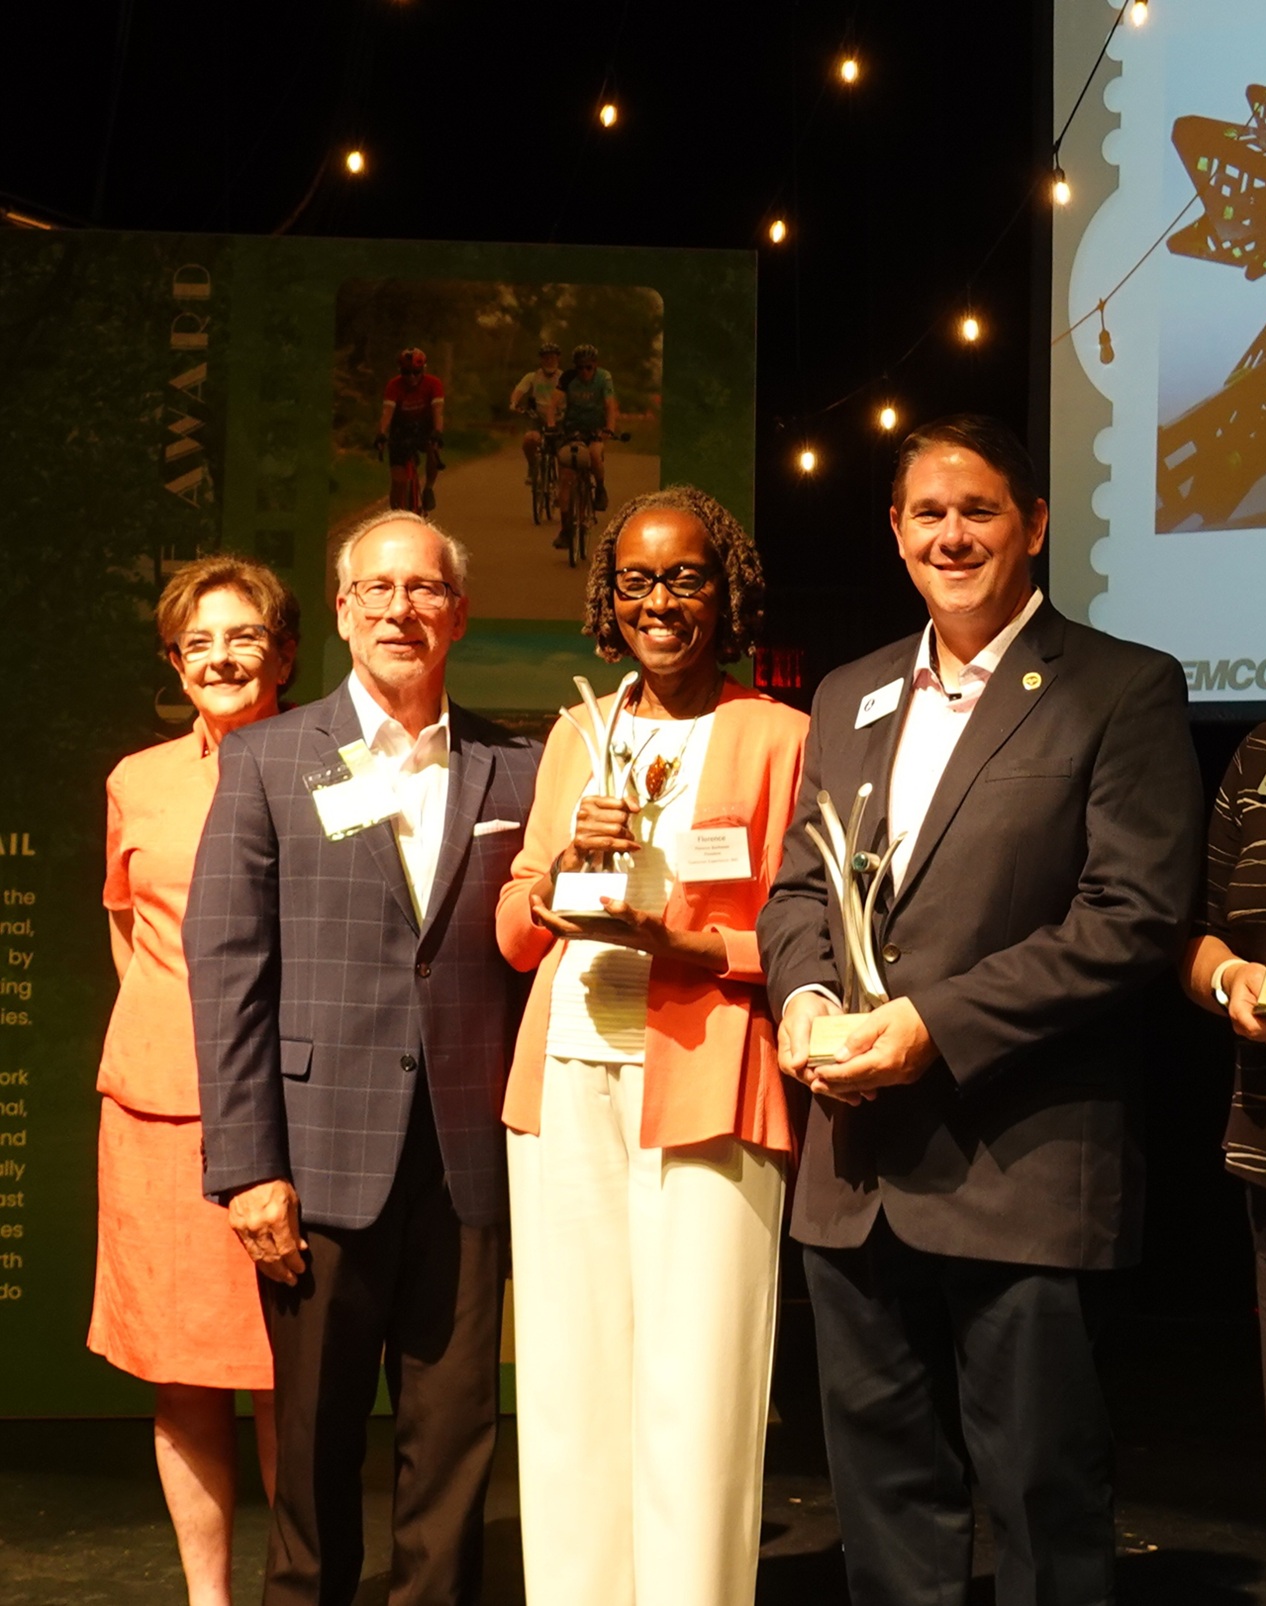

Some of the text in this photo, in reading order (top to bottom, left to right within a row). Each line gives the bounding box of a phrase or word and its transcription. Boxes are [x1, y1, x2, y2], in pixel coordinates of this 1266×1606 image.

[163, 263, 212, 508] AWARD
[3, 889, 36, 906] the
[8, 948, 34, 970] by
